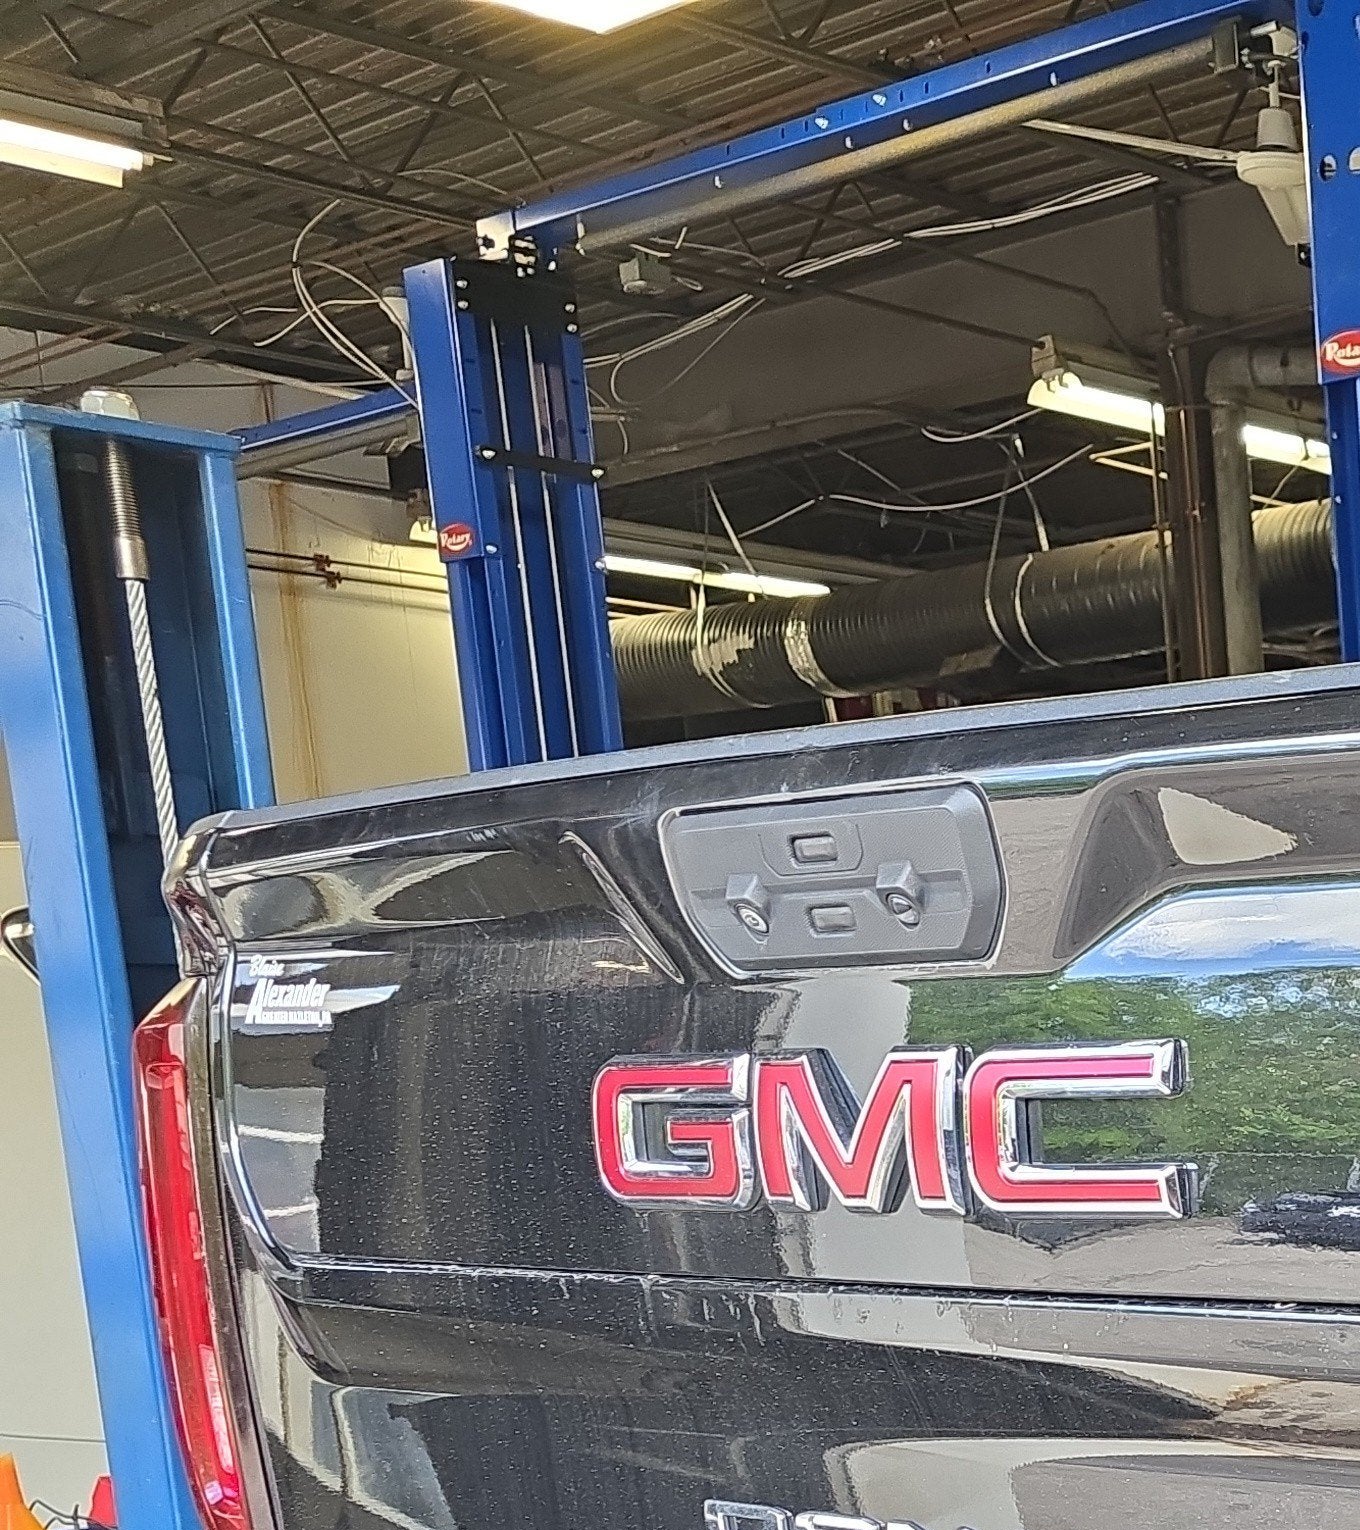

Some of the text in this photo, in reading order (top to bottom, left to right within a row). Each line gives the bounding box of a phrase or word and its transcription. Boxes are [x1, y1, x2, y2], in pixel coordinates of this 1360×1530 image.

[440, 532, 470, 552] Rotary
[245, 977, 332, 1024] Alexander
[593, 1037, 1199, 1219] GMC
